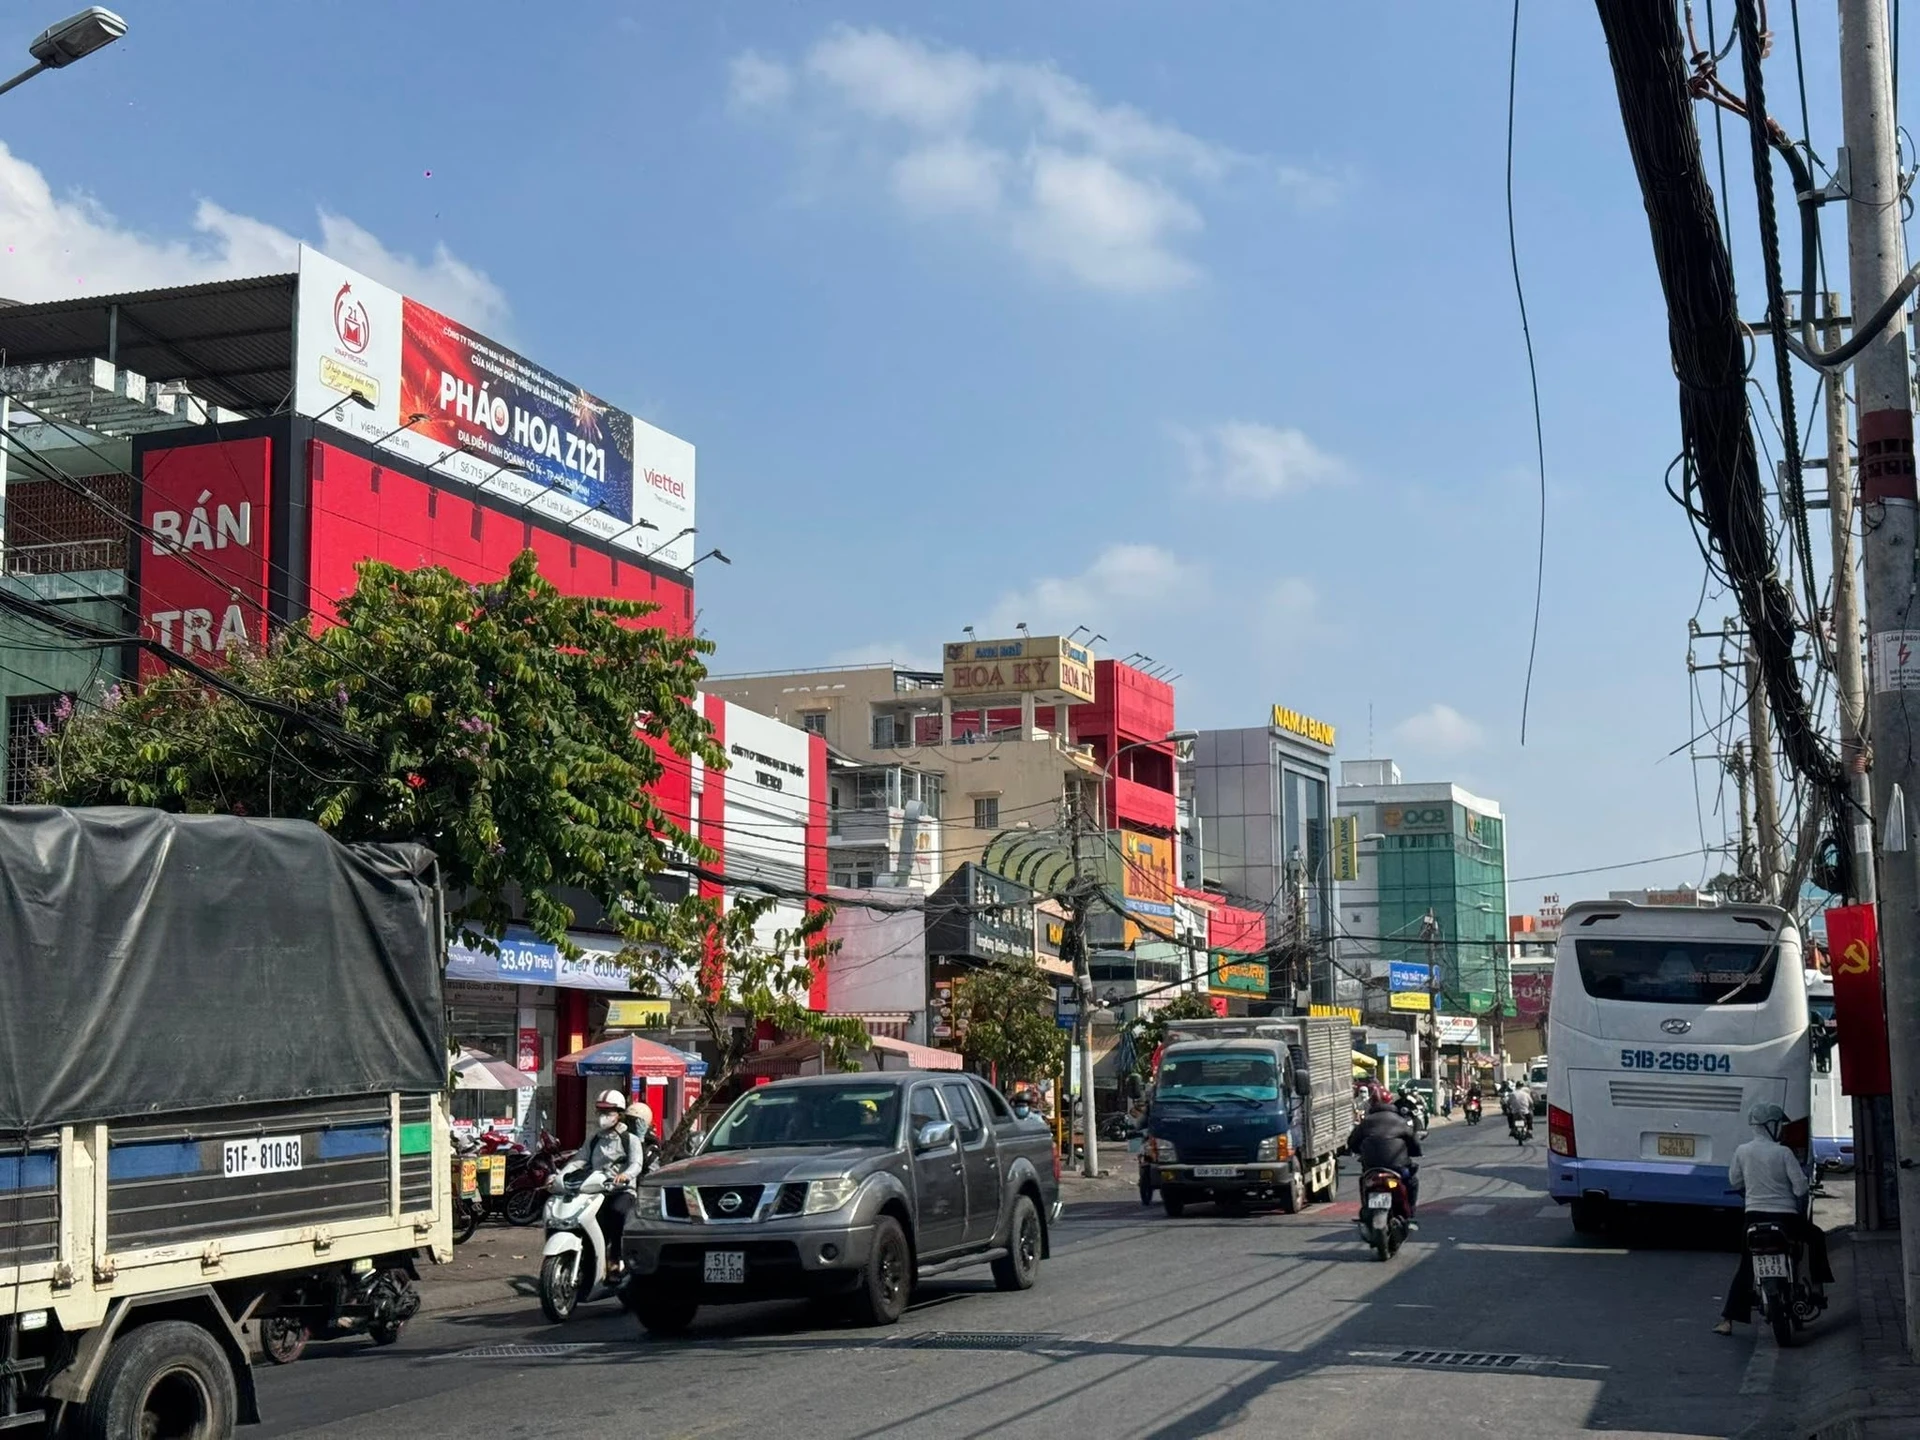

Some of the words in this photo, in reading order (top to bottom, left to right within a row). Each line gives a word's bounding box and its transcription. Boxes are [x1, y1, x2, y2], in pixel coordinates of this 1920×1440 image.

[347, 306, 358, 321] 21
[460, 335, 467, 345] TY
[471, 353, 486, 369] CỬA
[485, 361, 503, 378] HÀNG
[503, 370, 517, 384] GIỚI
[440, 371, 510, 436] PHÁO
[514, 406, 562, 462] HOA
[566, 432, 605, 482] Z121
[458, 429, 471, 445] ĐỊA
[471, 434, 488, 451] ĐIỂM
[488, 442, 503, 458] KINH
[503, 449, 526, 467] DOANH
[525, 458, 535, 472] SỐ
[460, 461, 470, 474] Số
[470, 465, 483, 480] 715
[643, 468, 686, 500] viettel
[152, 489, 251, 556] BÁN
[152, 586, 250, 655] TRẢ
[953, 665, 1005, 688] HOA
[1012, 659, 1051, 684] KỲ
[1061, 663, 1080, 690] HOA
[1081, 670, 1094, 695] KỲ
[1275, 704, 1300, 734] NAM
[1300, 714, 1309, 737] A
[1309, 717, 1336, 748] BANK
[1404, 809, 1445, 825] OCB
[1340, 819, 1349, 846] BANK
[1341, 846, 1349, 854] A
[1341, 856, 1350, 879] NAM
[1543, 892, 1560, 904] HỦ
[501, 948, 533, 972] 33.49
[534, 954, 554, 973] Triệu
[226, 1145, 248, 1174] 51F
[260, 1141, 300, 1170] 810.93
[713, 1253, 735, 1267] 51C
